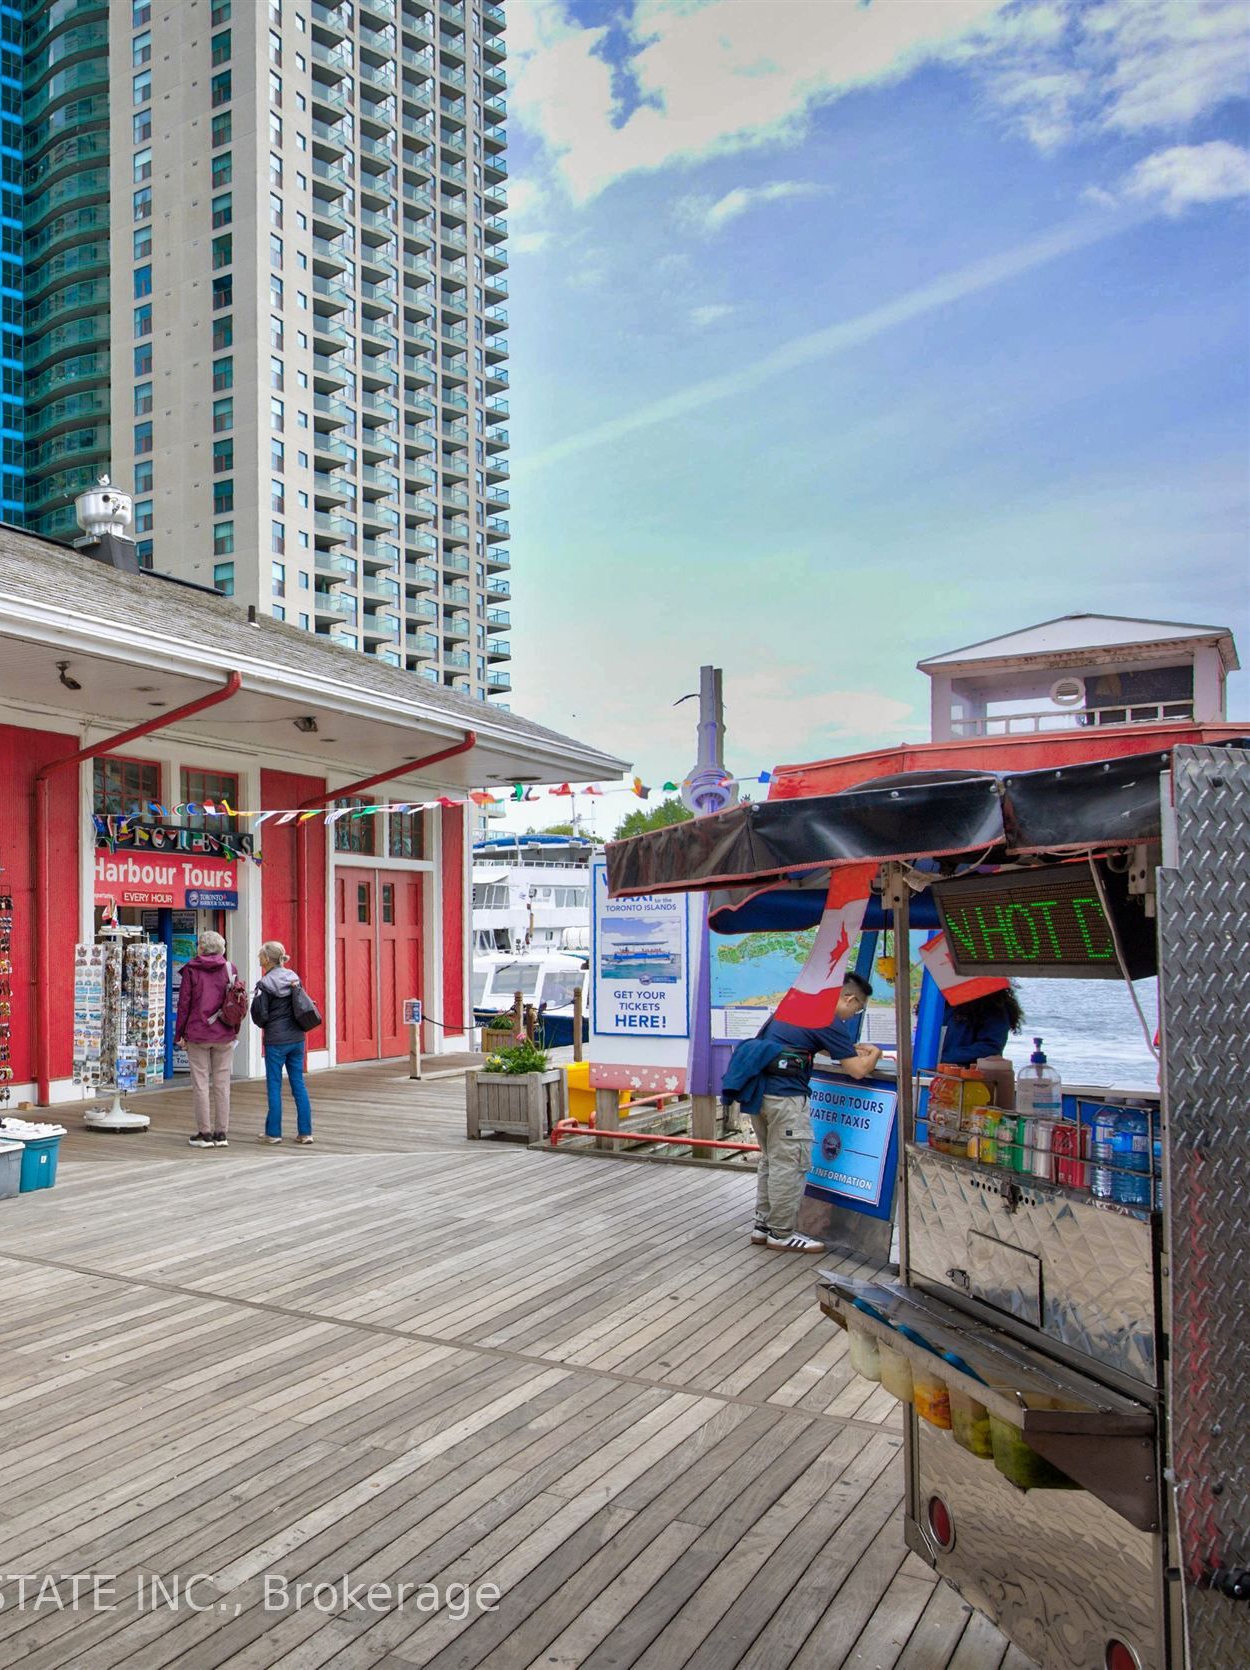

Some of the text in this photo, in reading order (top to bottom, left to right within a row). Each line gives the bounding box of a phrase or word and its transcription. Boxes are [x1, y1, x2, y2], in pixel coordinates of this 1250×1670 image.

[182, 863, 232, 888] Tours
[124, 891, 150, 902] EVERY
[151, 893, 173, 903] HOUR
[199, 893, 223, 901] TORONTO
[606, 903, 676, 912] TORONTO ISLANDS
[975, 901, 1062, 959] HOT
[614, 991, 666, 1000] GET YOUR
[619, 1002, 660, 1011] TICKETS
[615, 1015, 666, 1028] HERE!
[849, 1096, 884, 1114] TOURS
[841, 1113, 870, 1130] TAXIS
[815, 1167, 873, 1190] INFORMATION
